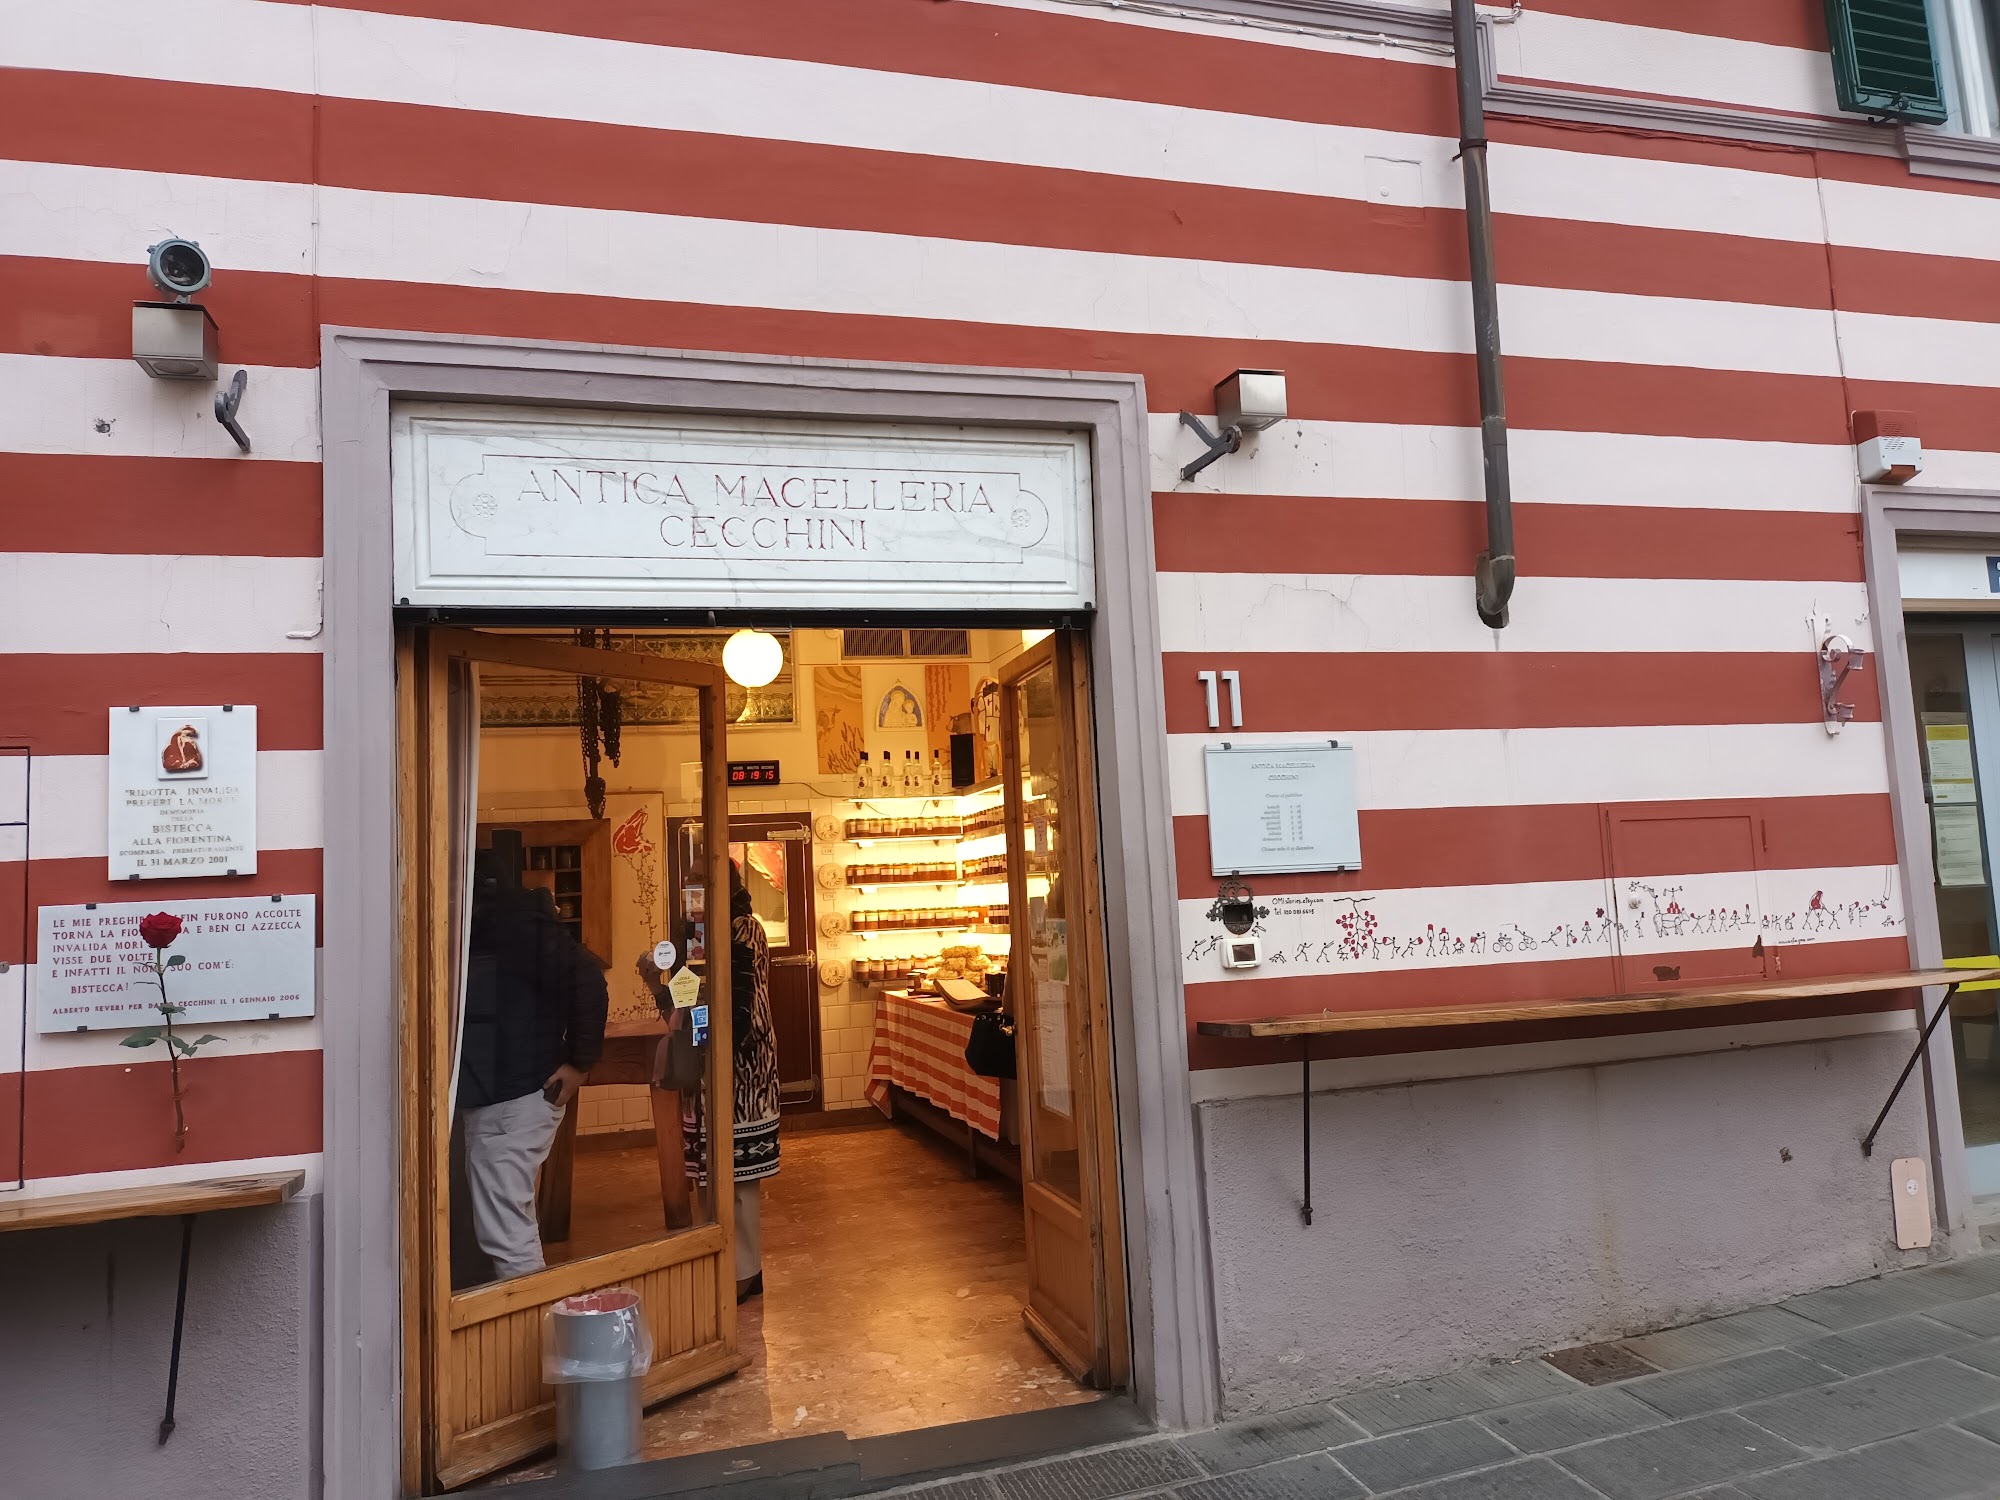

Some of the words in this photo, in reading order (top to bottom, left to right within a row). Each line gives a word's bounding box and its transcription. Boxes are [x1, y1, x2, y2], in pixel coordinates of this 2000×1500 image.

[517, 469, 694, 505] ANTICA
[714, 474, 996, 513] MACELLERIA
[660, 515, 868, 551] CECCHINI
[1198, 670, 1243, 728] 11
[179, 798, 194, 806] LA
[152, 824, 213, 834] BISTECCA
[132, 837, 162, 846] ALLA
[166, 835, 232, 845] FIORENTINA
[136, 859, 147, 867] IL
[151, 858, 160, 866] 31
[164, 857, 205, 866] MARZO
[208, 856, 228, 864] 2001
[53, 920, 66, 928] LE
[72, 918, 92, 927] MIE
[204, 911, 249, 921] FURONO
[255, 909, 302, 919] ACCOLTE
[196, 925, 203, 933] E
[209, 924, 229, 933] BEN
[235, 923, 245, 932] CI
[252, 921, 302, 931] AZZECCA
[52, 931, 94, 940] TORNA
[100, 930, 115, 938] LA
[53, 942, 108, 952] INVALIDA
[52, 956, 83, 965] VISSE
[90, 955, 112, 964] DUE
[119, 952, 154, 962] VOLTE
[52, 970, 58, 978] E
[65, 967, 110, 977] INFATTI
[116, 966, 126, 975] IL
[170, 963, 192, 972] SUO
[71, 982, 129, 994] BISTECCA!
[52, 1006, 90, 1015] ALBERTO
[94, 1004, 124, 1012] SEVERI
[178, 999, 216, 1007] CECCHINI
[239, 996, 276, 1004] GENNAIO
